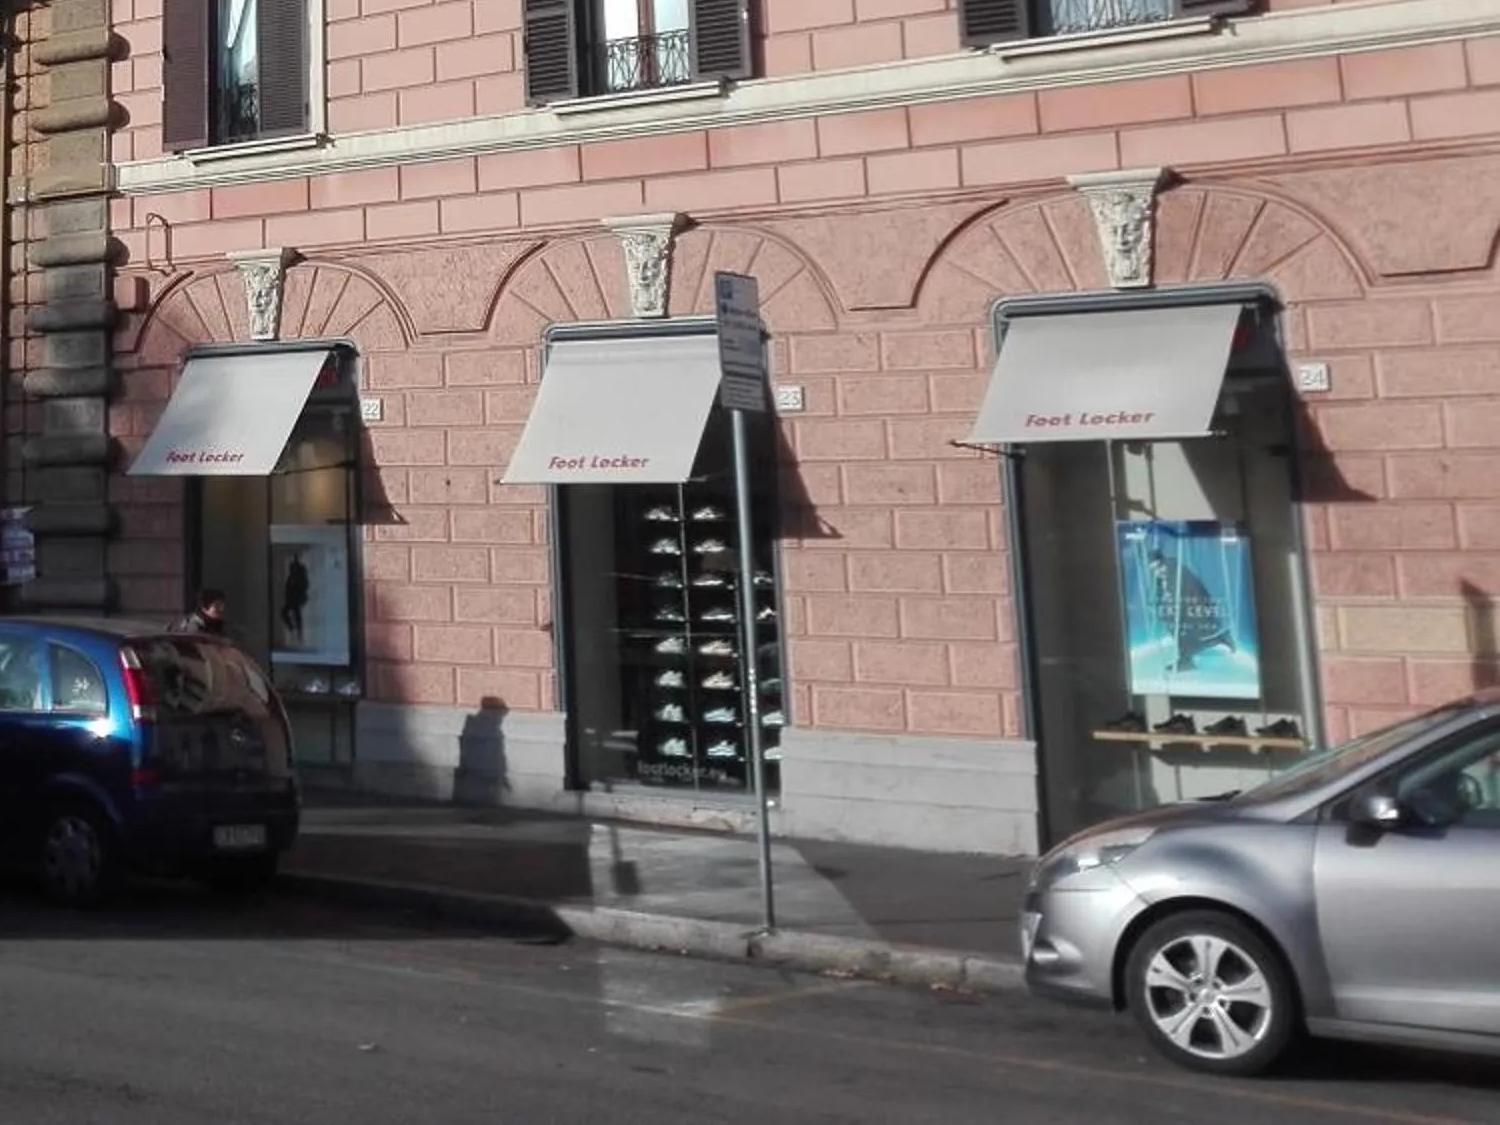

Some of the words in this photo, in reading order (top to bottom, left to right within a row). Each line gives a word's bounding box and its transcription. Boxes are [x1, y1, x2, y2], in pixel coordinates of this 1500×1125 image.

[781, 390, 801, 406] 23
[364, 402, 379, 417] 22
[1024, 413, 1072, 427] Foot
[1079, 411, 1156, 425] Locker
[165, 450, 196, 463] Foot
[198, 450, 245, 463] Locker
[547, 455, 585, 470] Foot
[590, 453, 651, 469] Locker
